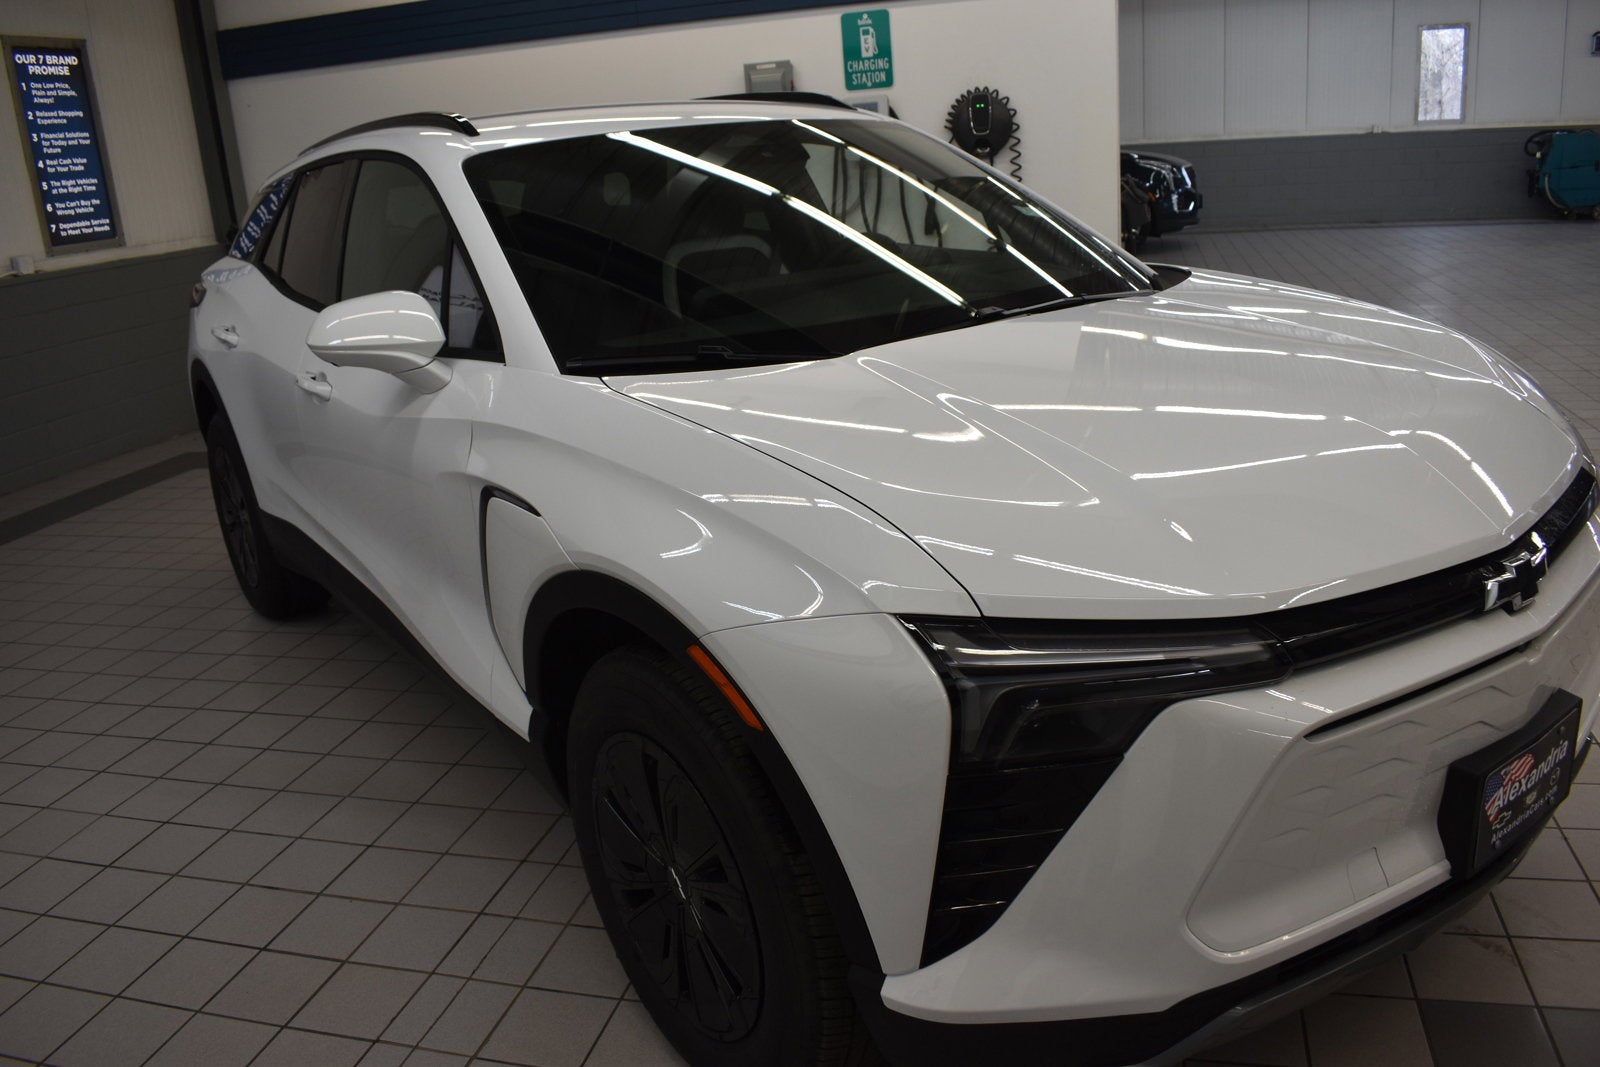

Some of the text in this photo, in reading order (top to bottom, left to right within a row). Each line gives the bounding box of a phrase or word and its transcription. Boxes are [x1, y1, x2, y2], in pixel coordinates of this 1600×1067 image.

[15, 54, 78, 65] OUR 7 BRAND
[847, 58, 889, 72] CHARGING
[28, 65, 70, 75] PROMISE
[852, 72, 886, 85] STATION
[21, 82, 26, 91] 1
[28, 111, 34, 119] 2
[32, 133, 38, 142] 3
[38, 160, 44, 168] 4
[42, 182, 48, 190] 5
[46, 204, 52, 212] 6
[59, 220, 90, 229] Dependable
[1488, 740, 1568, 815] Alexandria
